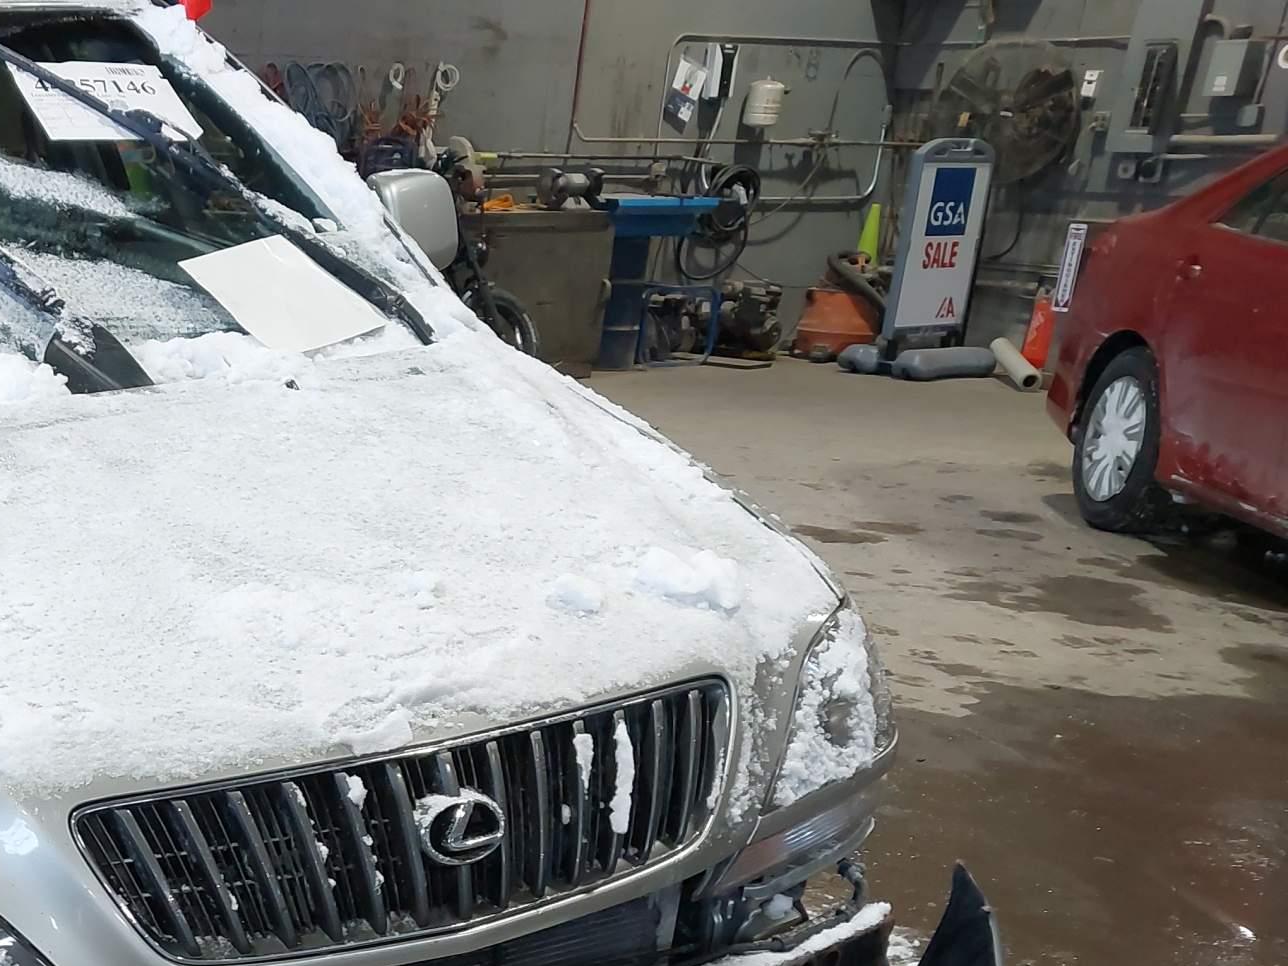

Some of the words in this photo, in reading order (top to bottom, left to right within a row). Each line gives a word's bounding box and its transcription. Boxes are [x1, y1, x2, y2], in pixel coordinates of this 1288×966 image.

[34, 78, 156, 96] 457146
[930, 201, 965, 226] GSA
[922, 241, 960, 270] SALE
